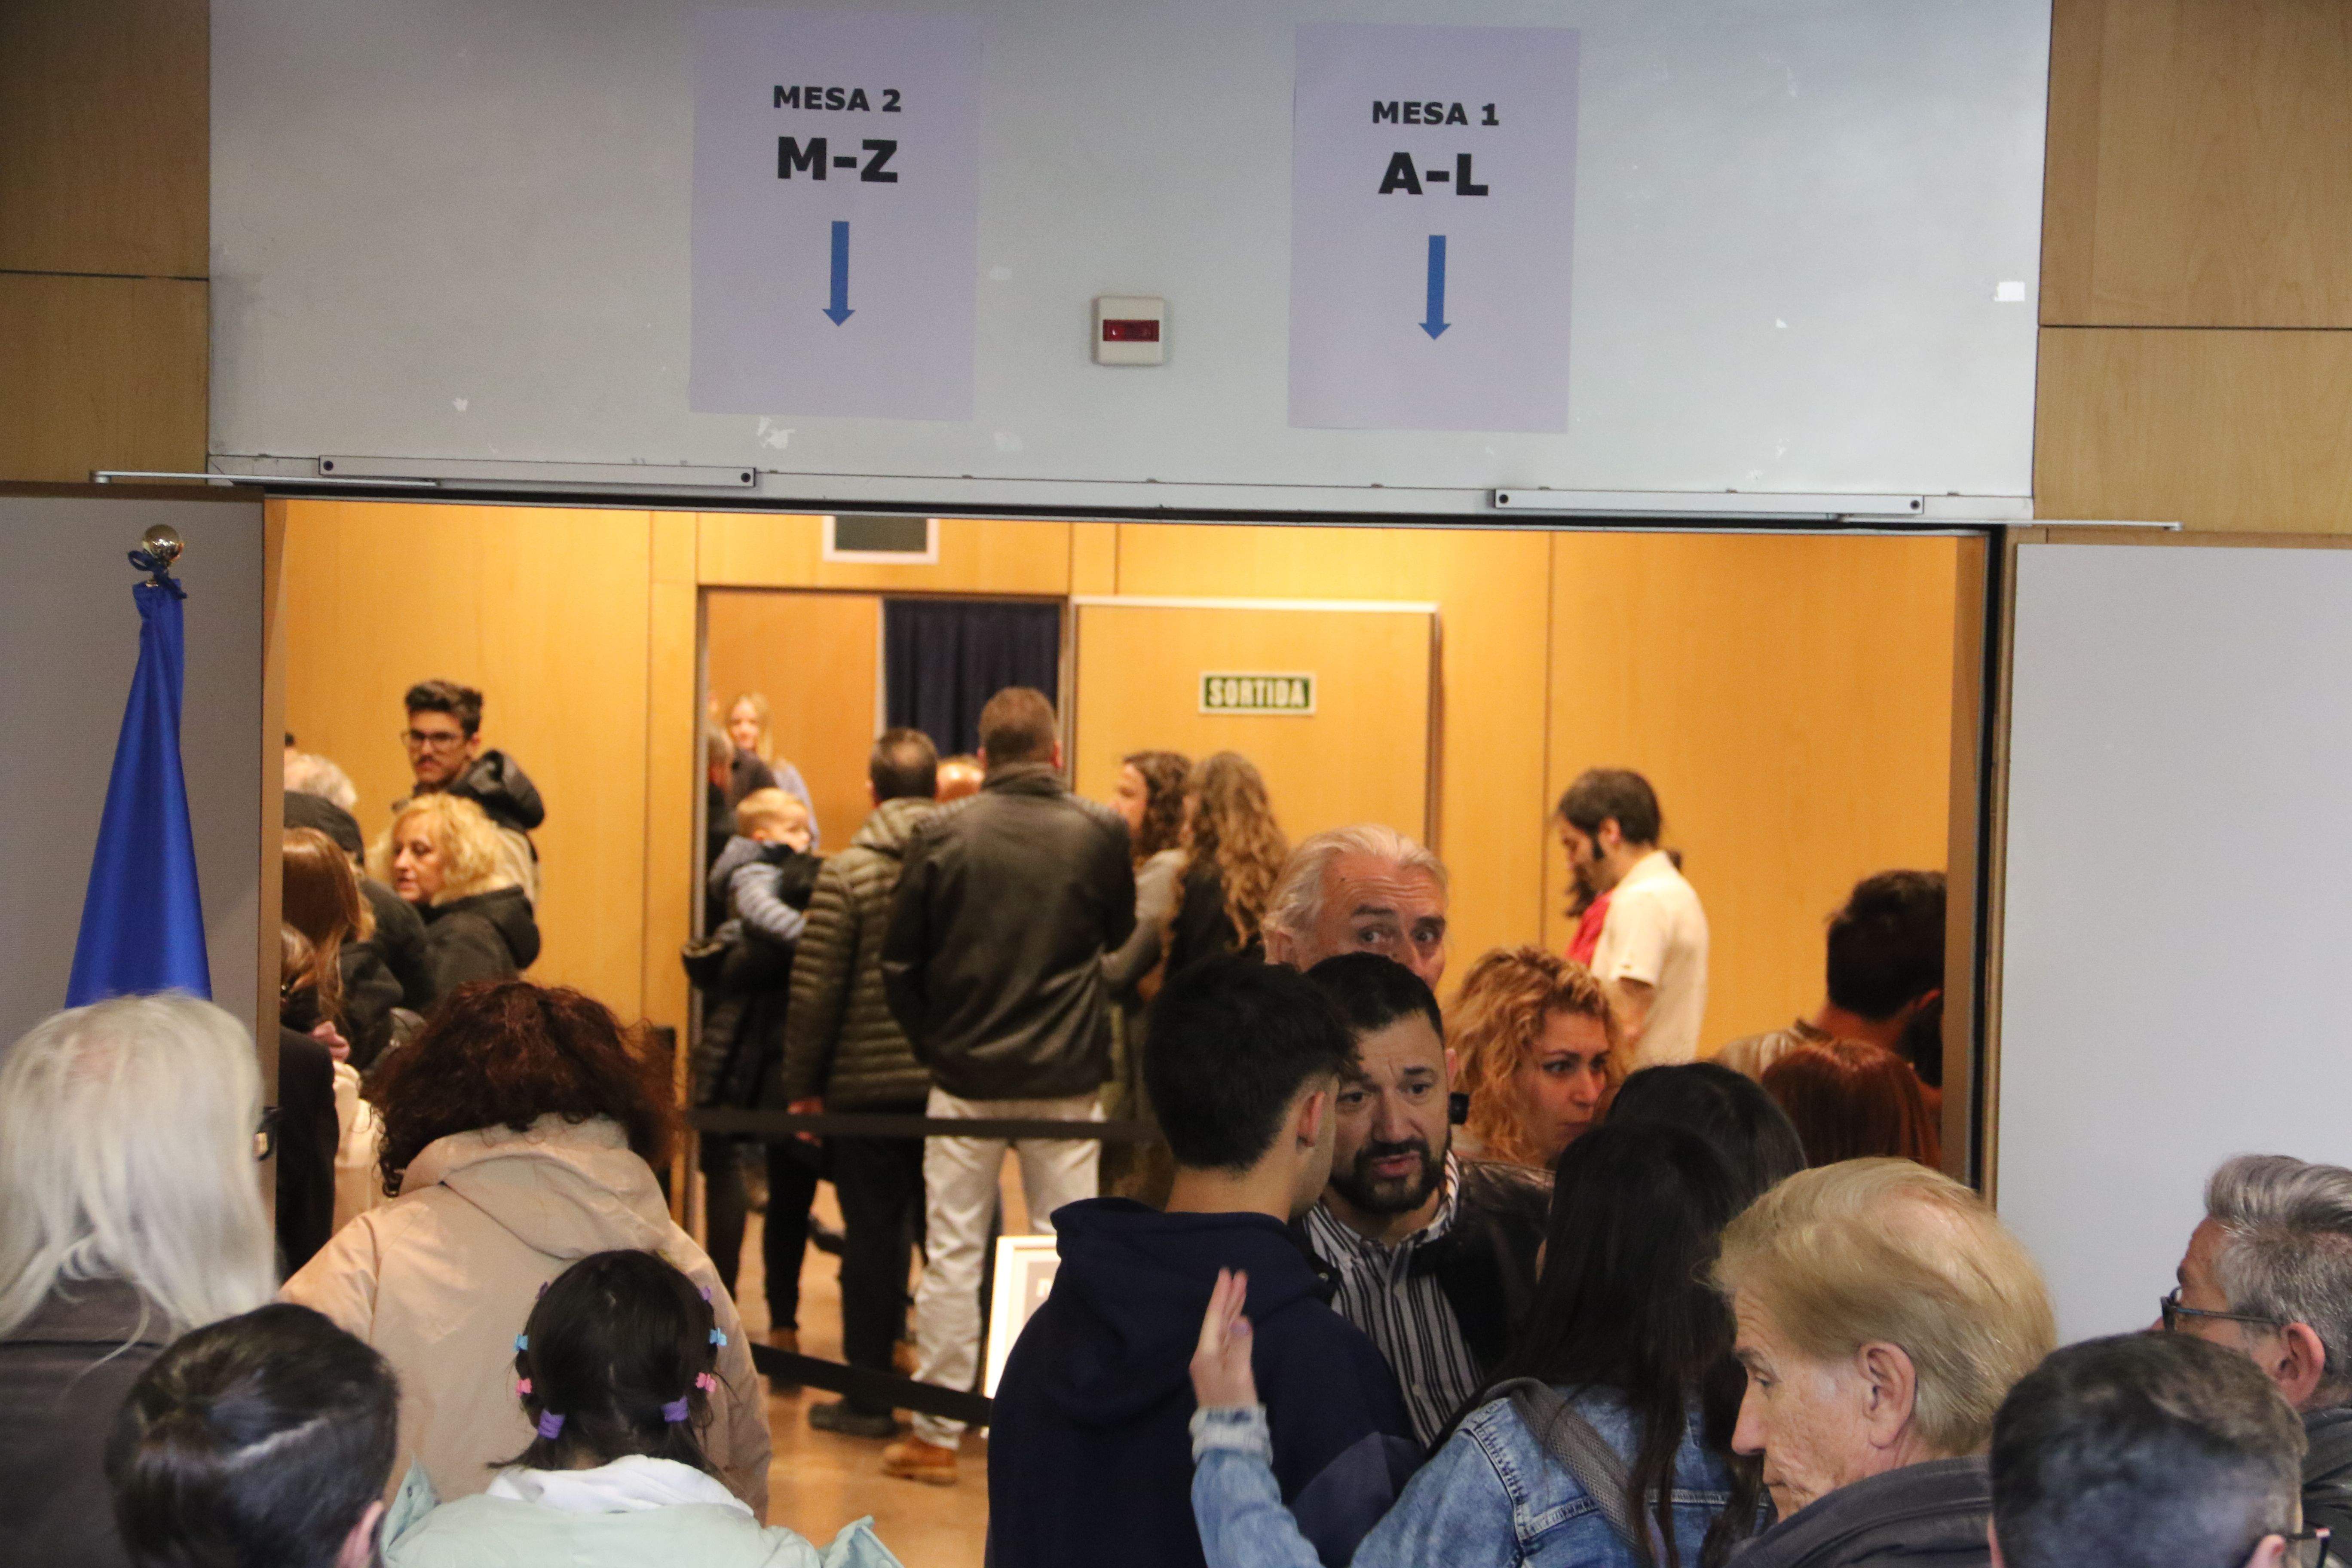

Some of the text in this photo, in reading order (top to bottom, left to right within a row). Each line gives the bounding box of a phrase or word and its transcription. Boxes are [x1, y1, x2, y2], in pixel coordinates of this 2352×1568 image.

[773, 85, 902, 113] MESA 2
[1372, 100, 1500, 126] MESA 1
[777, 136, 898, 183] M-Z
[1378, 151, 1488, 196] A-L
[1209, 679, 1305, 706] SORTIDA
